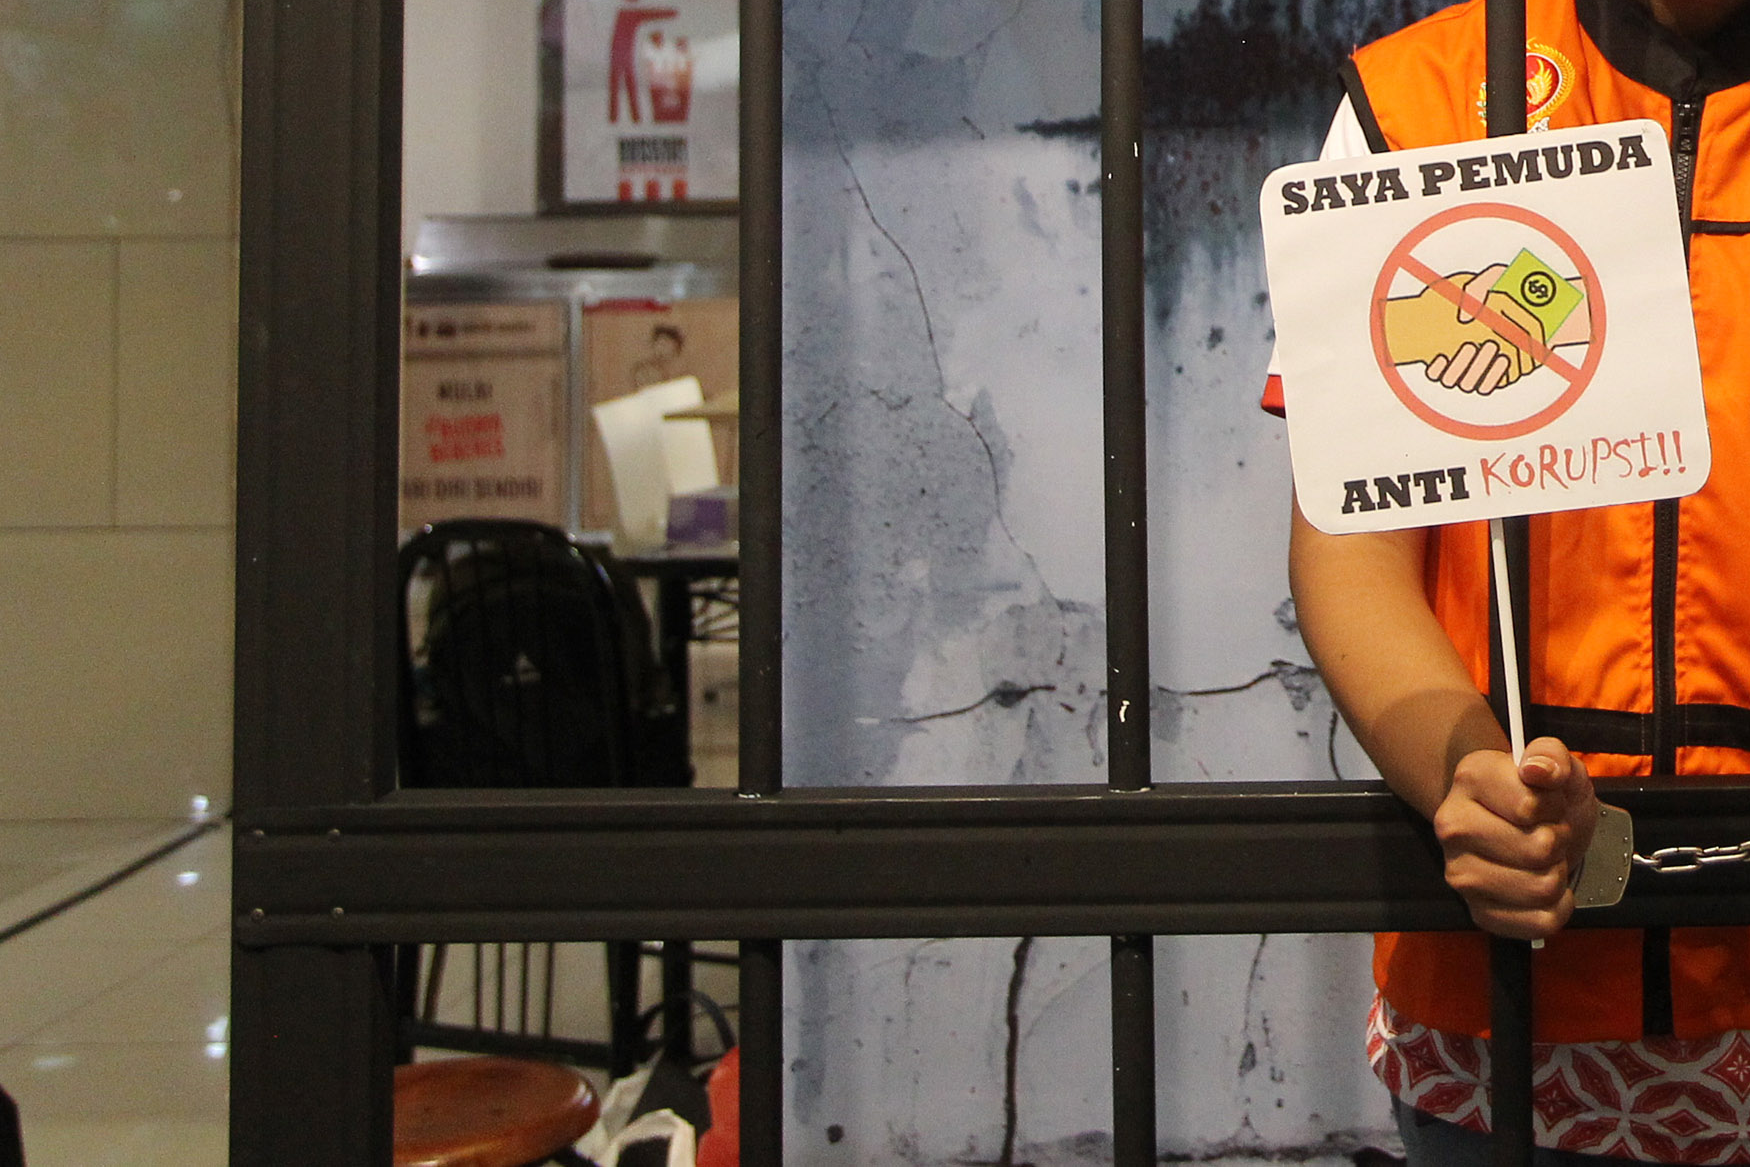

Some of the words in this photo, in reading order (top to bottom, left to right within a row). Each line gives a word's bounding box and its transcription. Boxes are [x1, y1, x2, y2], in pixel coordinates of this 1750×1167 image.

[1281, 168, 1409, 216] SAYA
[1418, 135, 1652, 196] PEMUDA
[1341, 467, 1470, 515] ANTI
[1479, 430, 1687, 497] KORUPSI!!
